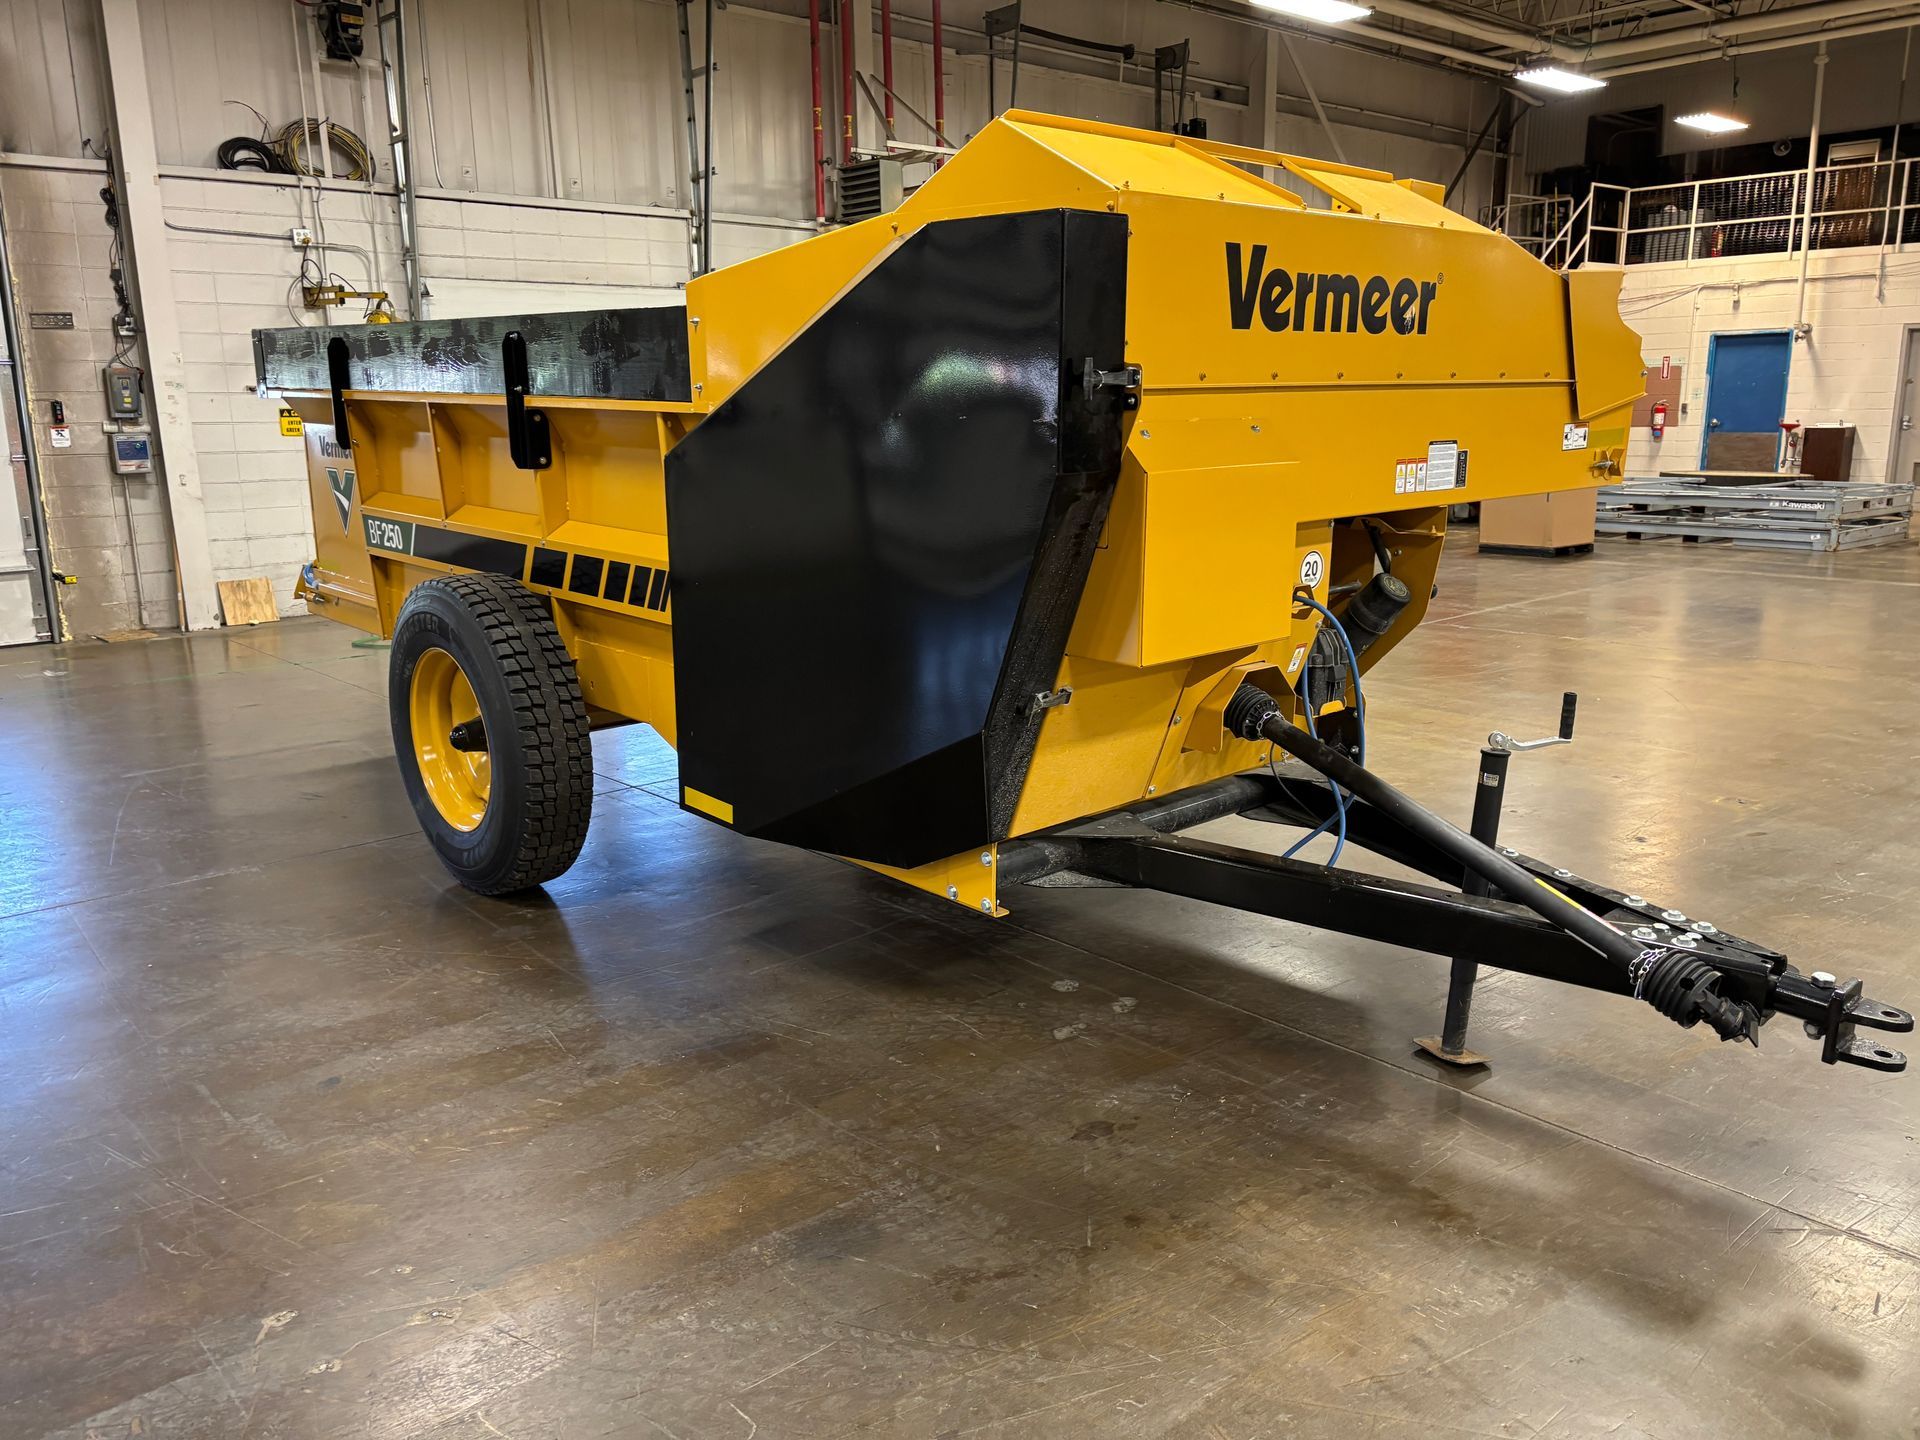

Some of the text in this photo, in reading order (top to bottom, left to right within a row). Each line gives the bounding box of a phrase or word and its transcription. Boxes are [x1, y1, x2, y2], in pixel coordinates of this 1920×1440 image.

[1225, 242, 1437, 335] Vermeer
[318, 435, 353, 459] Verme
[1782, 500, 1825, 510] Kawasaki
[1303, 560, 1318, 577] 20
